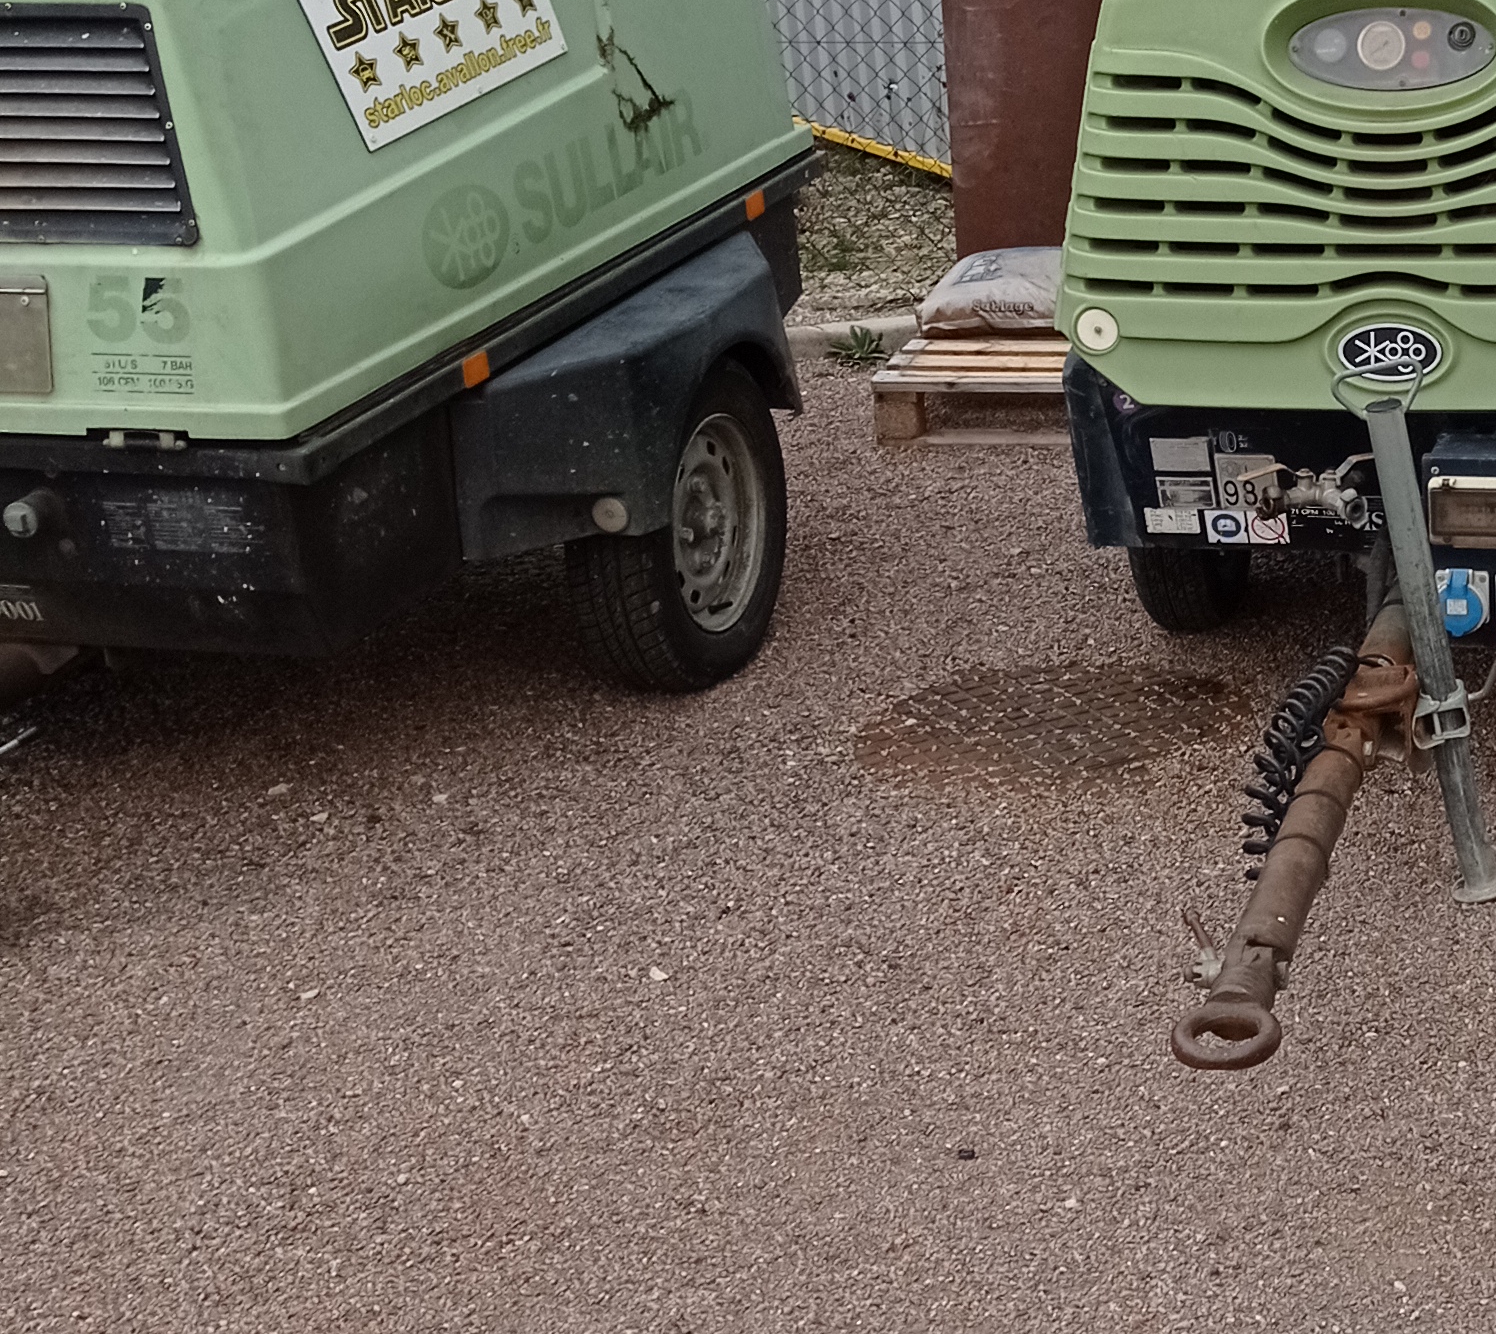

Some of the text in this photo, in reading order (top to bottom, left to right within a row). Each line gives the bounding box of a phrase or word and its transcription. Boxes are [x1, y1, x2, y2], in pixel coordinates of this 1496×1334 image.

[364, 17, 553, 129] starloc.avallon.free.fr
[513, 85, 704, 245] SULLAIR
[1223, 480, 1258, 506] 98
